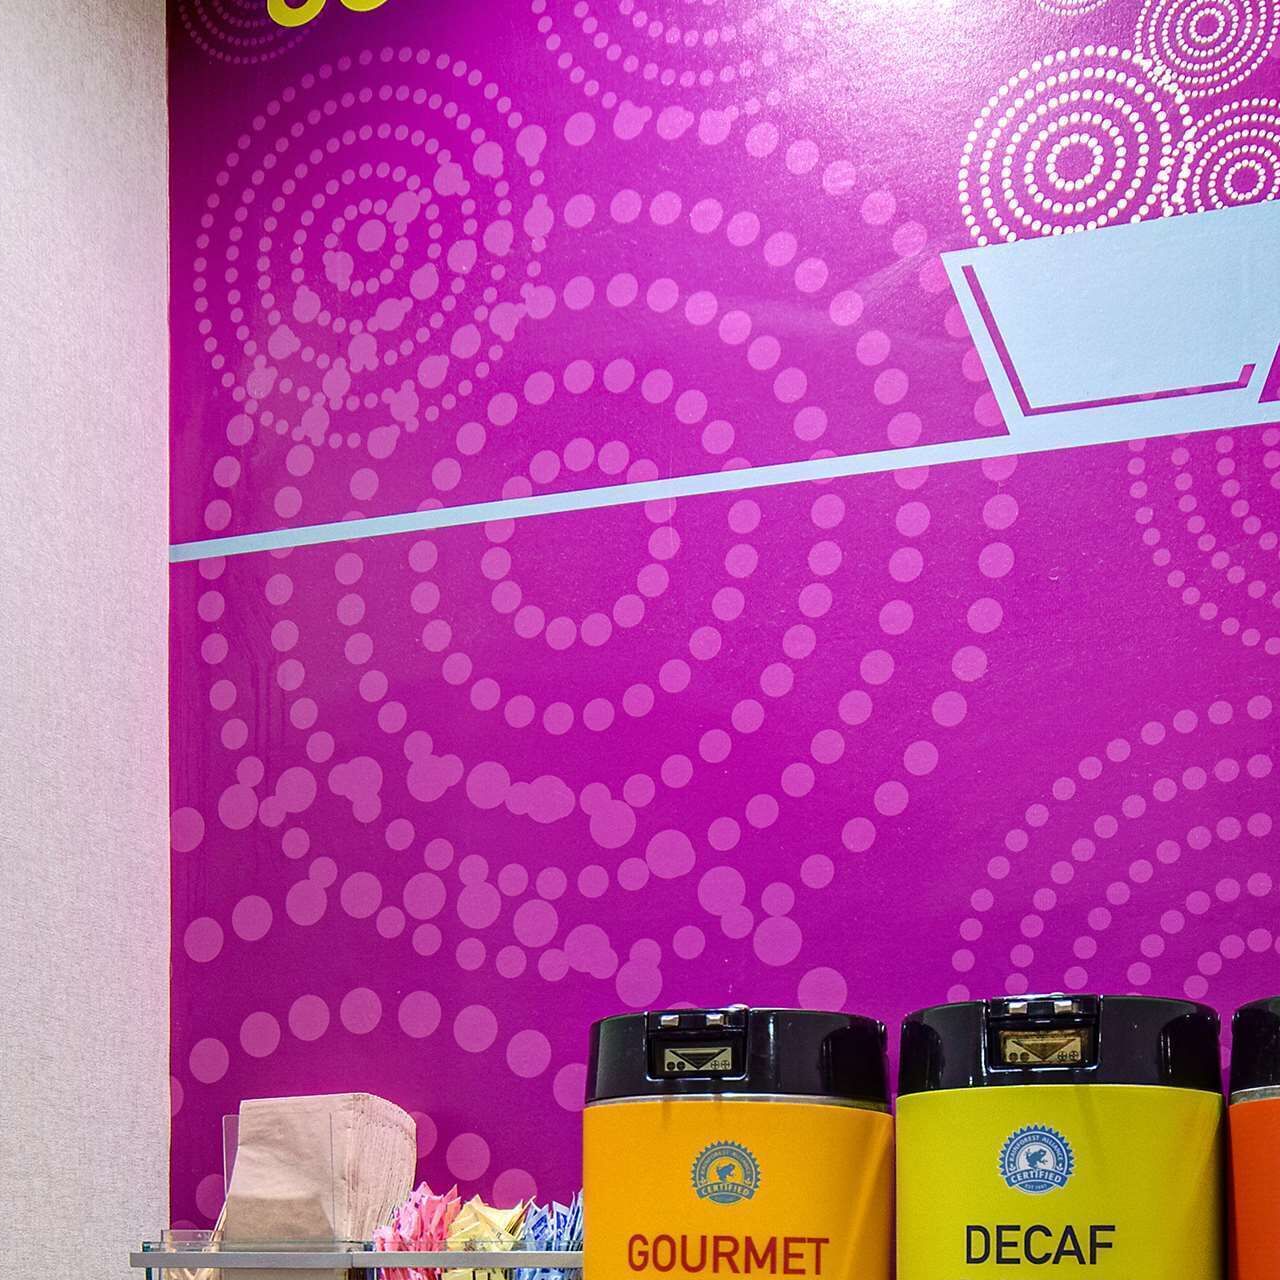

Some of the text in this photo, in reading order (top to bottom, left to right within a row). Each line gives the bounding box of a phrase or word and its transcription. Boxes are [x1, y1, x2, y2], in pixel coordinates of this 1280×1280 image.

[1009, 1135, 1064, 1162] RAINFOREST ALLIANCE
[700, 1184, 750, 1196] CERTIFIED
[1010, 1171, 1062, 1183] CERTIFIED
[627, 1235, 830, 1276] GOURMET
[965, 1225, 1116, 1266] DECAF
